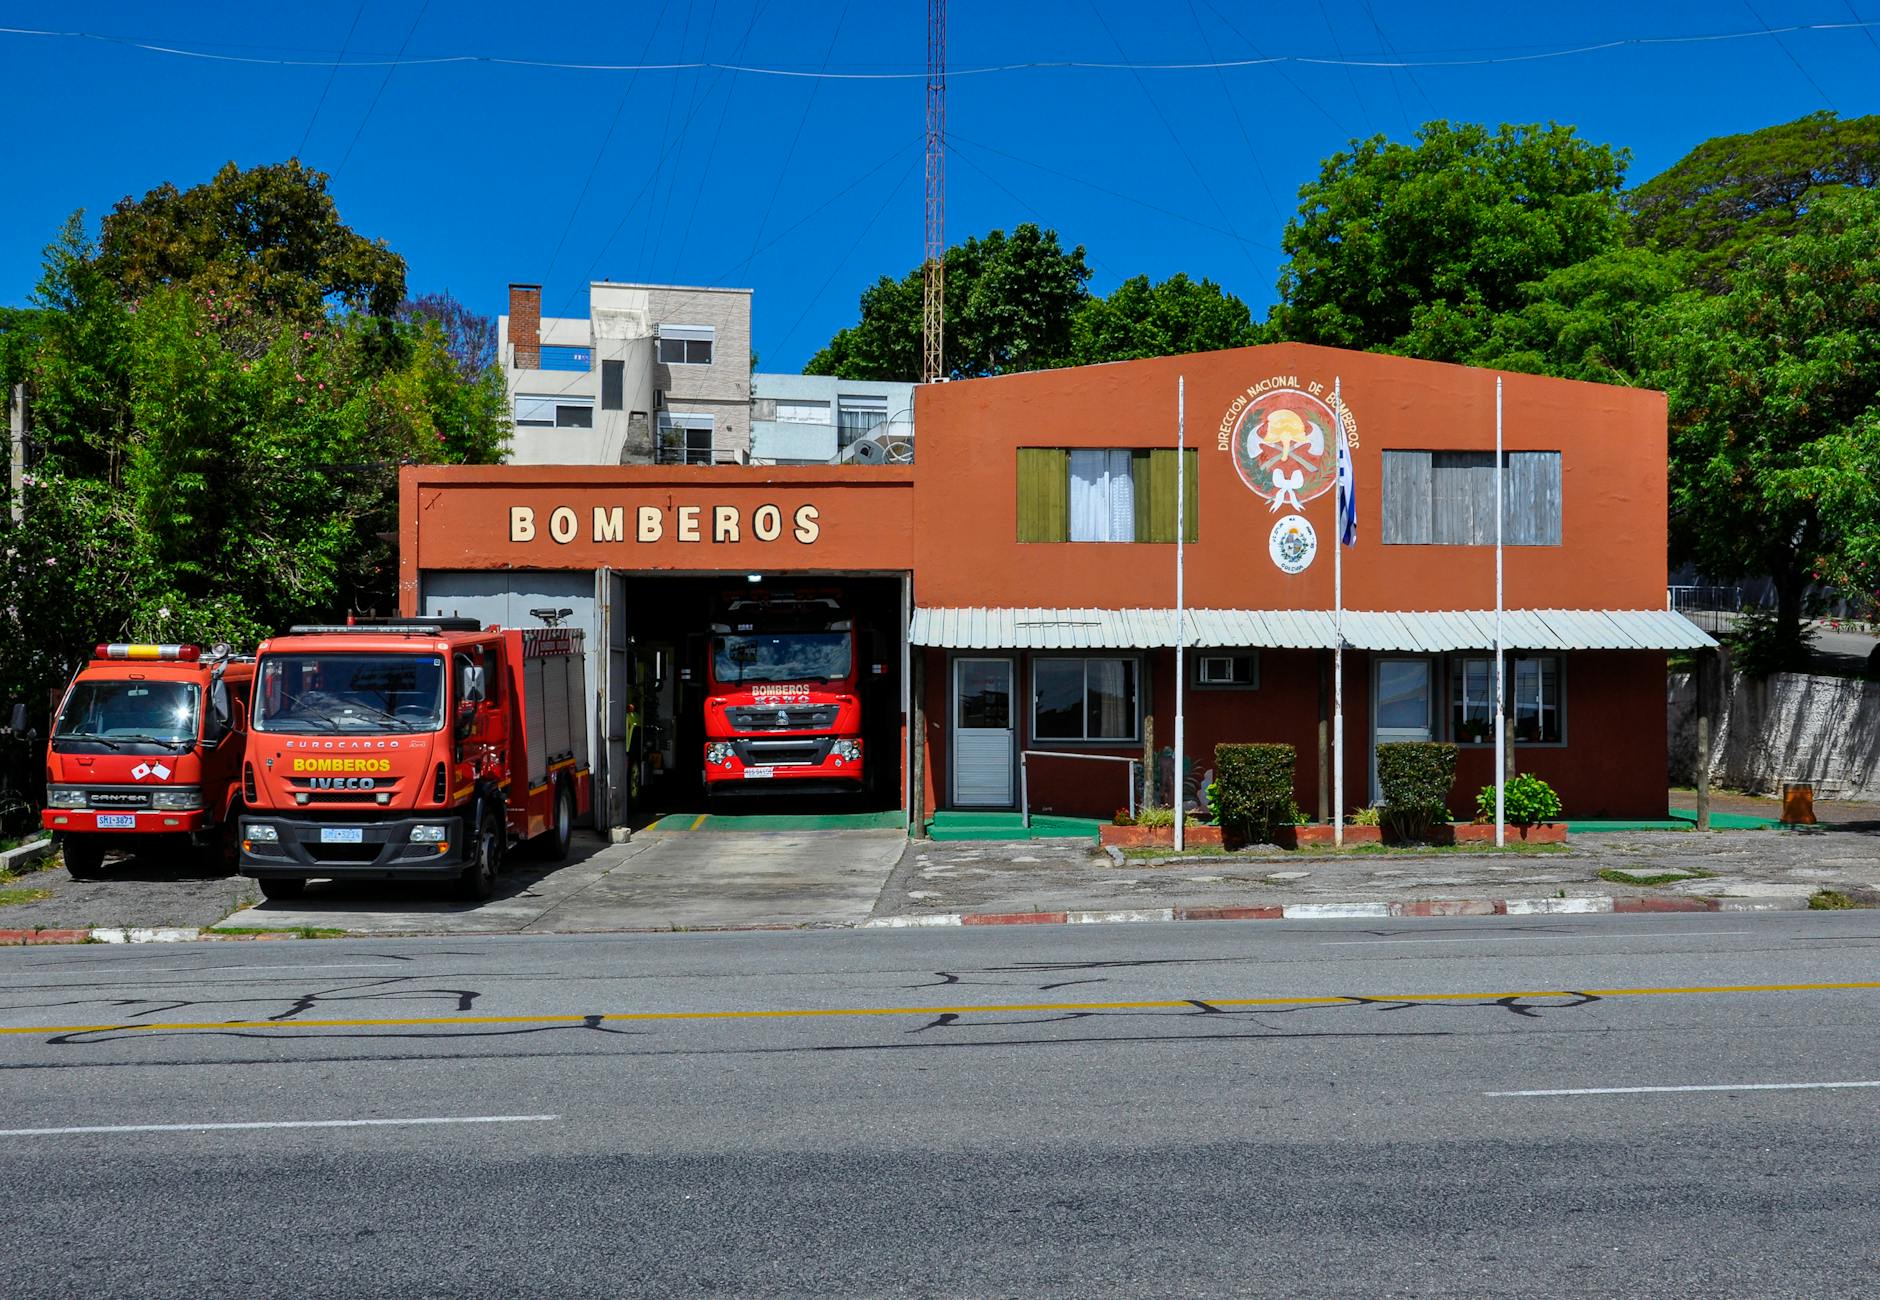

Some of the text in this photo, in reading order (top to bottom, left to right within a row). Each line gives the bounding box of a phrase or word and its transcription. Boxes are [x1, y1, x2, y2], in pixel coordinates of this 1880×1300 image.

[1246, 375, 1300, 397] NACIONAL
[1307, 380, 1324, 396] DE
[509, 503, 820, 544] BOMBEROS
[751, 684, 810, 696] BOMBEROS
[293, 758, 391, 772] BOMBEROS
[310, 777, 375, 790] IVECO
